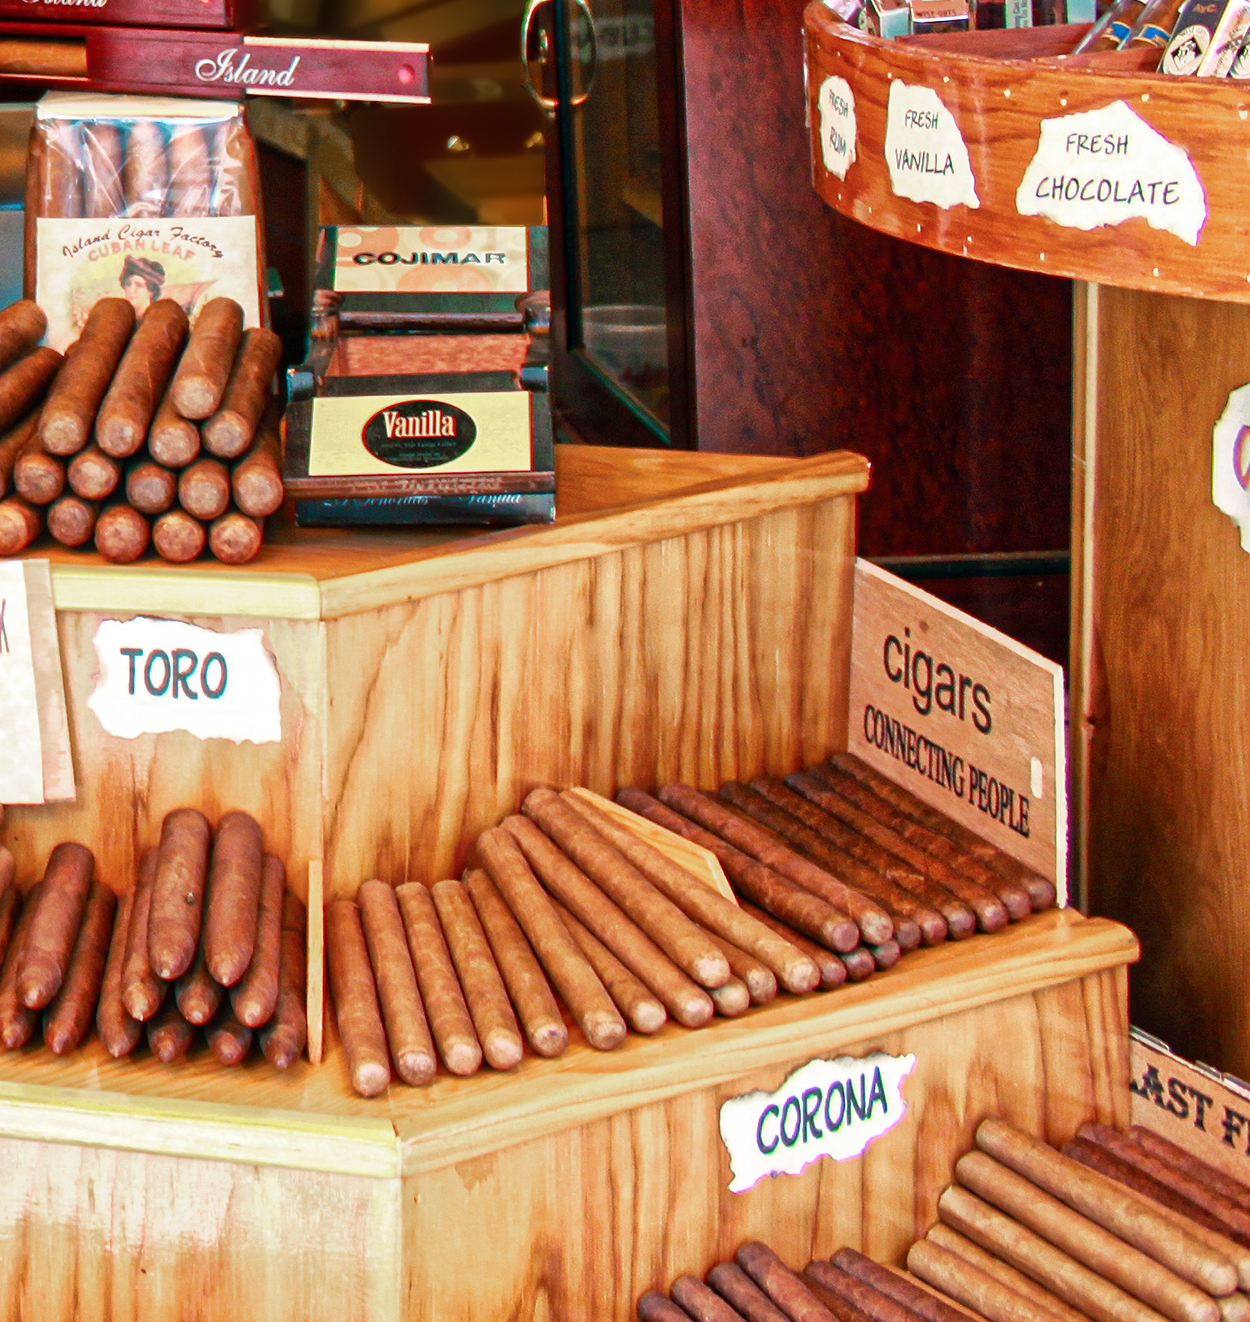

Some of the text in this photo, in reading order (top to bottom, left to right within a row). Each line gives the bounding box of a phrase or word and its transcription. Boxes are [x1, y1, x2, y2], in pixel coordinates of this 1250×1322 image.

[194, 49, 301, 87] Island
[829, 89, 849, 119] FRESH
[904, 109, 939, 129] FRESH
[829, 126, 846, 157] RUM
[1066, 133, 1129, 156] FRESH
[894, 148, 955, 175] VANILLA
[1035, 176, 1180, 206] CHOCOLATE
[62, 224, 224, 259] Island Cigar Factory
[88, 238, 196, 262] CUBAN LEAF
[353, 251, 507, 266] COJIMAR
[382, 409, 457, 439] Vanilla
[121, 648, 228, 700] TORO
[883, 627, 992, 735] cigars
[863, 704, 1030, 838] CONNECTING PEOPLE
[757, 1066, 888, 1154] CORONA
[1130, 1063, 1250, 1157] AST F
